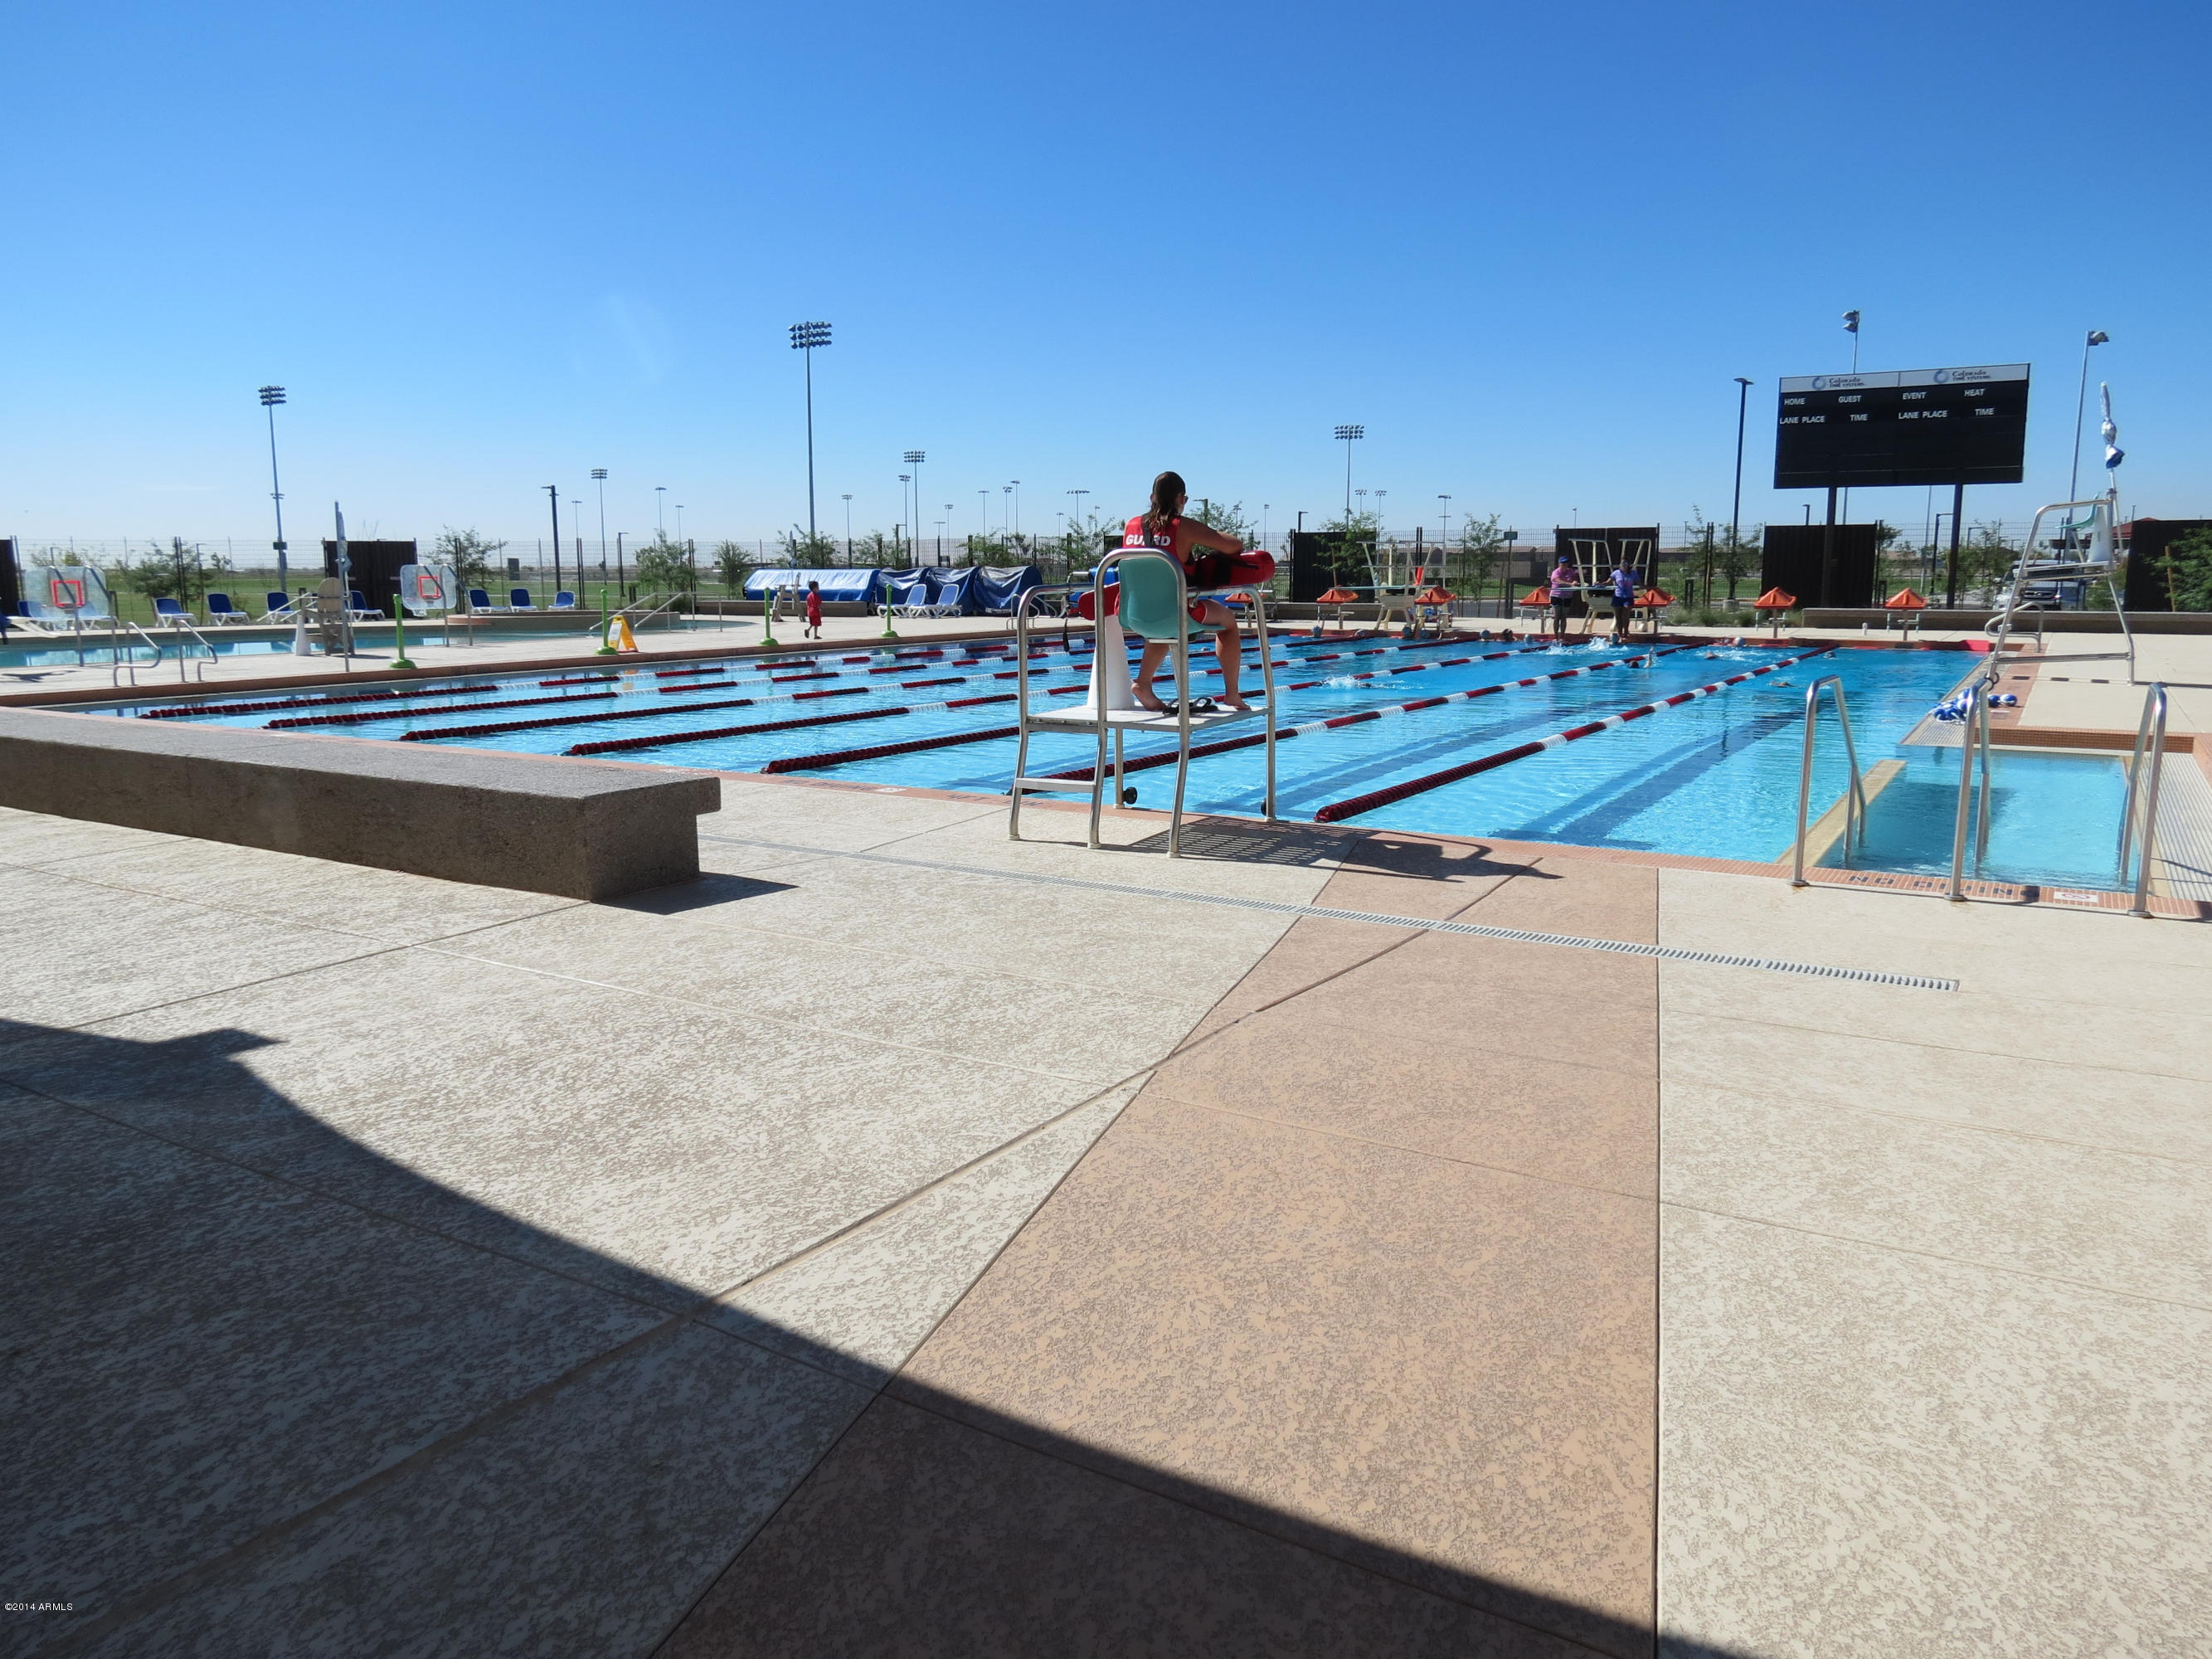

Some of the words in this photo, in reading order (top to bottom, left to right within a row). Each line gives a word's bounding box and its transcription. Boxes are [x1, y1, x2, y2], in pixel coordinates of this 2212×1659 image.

[1902, 392, 1927, 400] EVENT
[1964, 388, 1986, 397] HEAT
[1784, 397, 1806, 406] HOME
[1838, 395, 1862, 404] GUEST
[1898, 411, 1919, 420] LANE
[1922, 410, 1948, 418] PLACE
[1975, 407, 1995, 416] TIME
[1779, 416, 1799, 425] LANE
[1801, 416, 1826, 424] PLACE
[1850, 414, 1868, 422] TIME
[1125, 533, 1171, 547] GURD
[1850, 875, 1894, 884] NO
